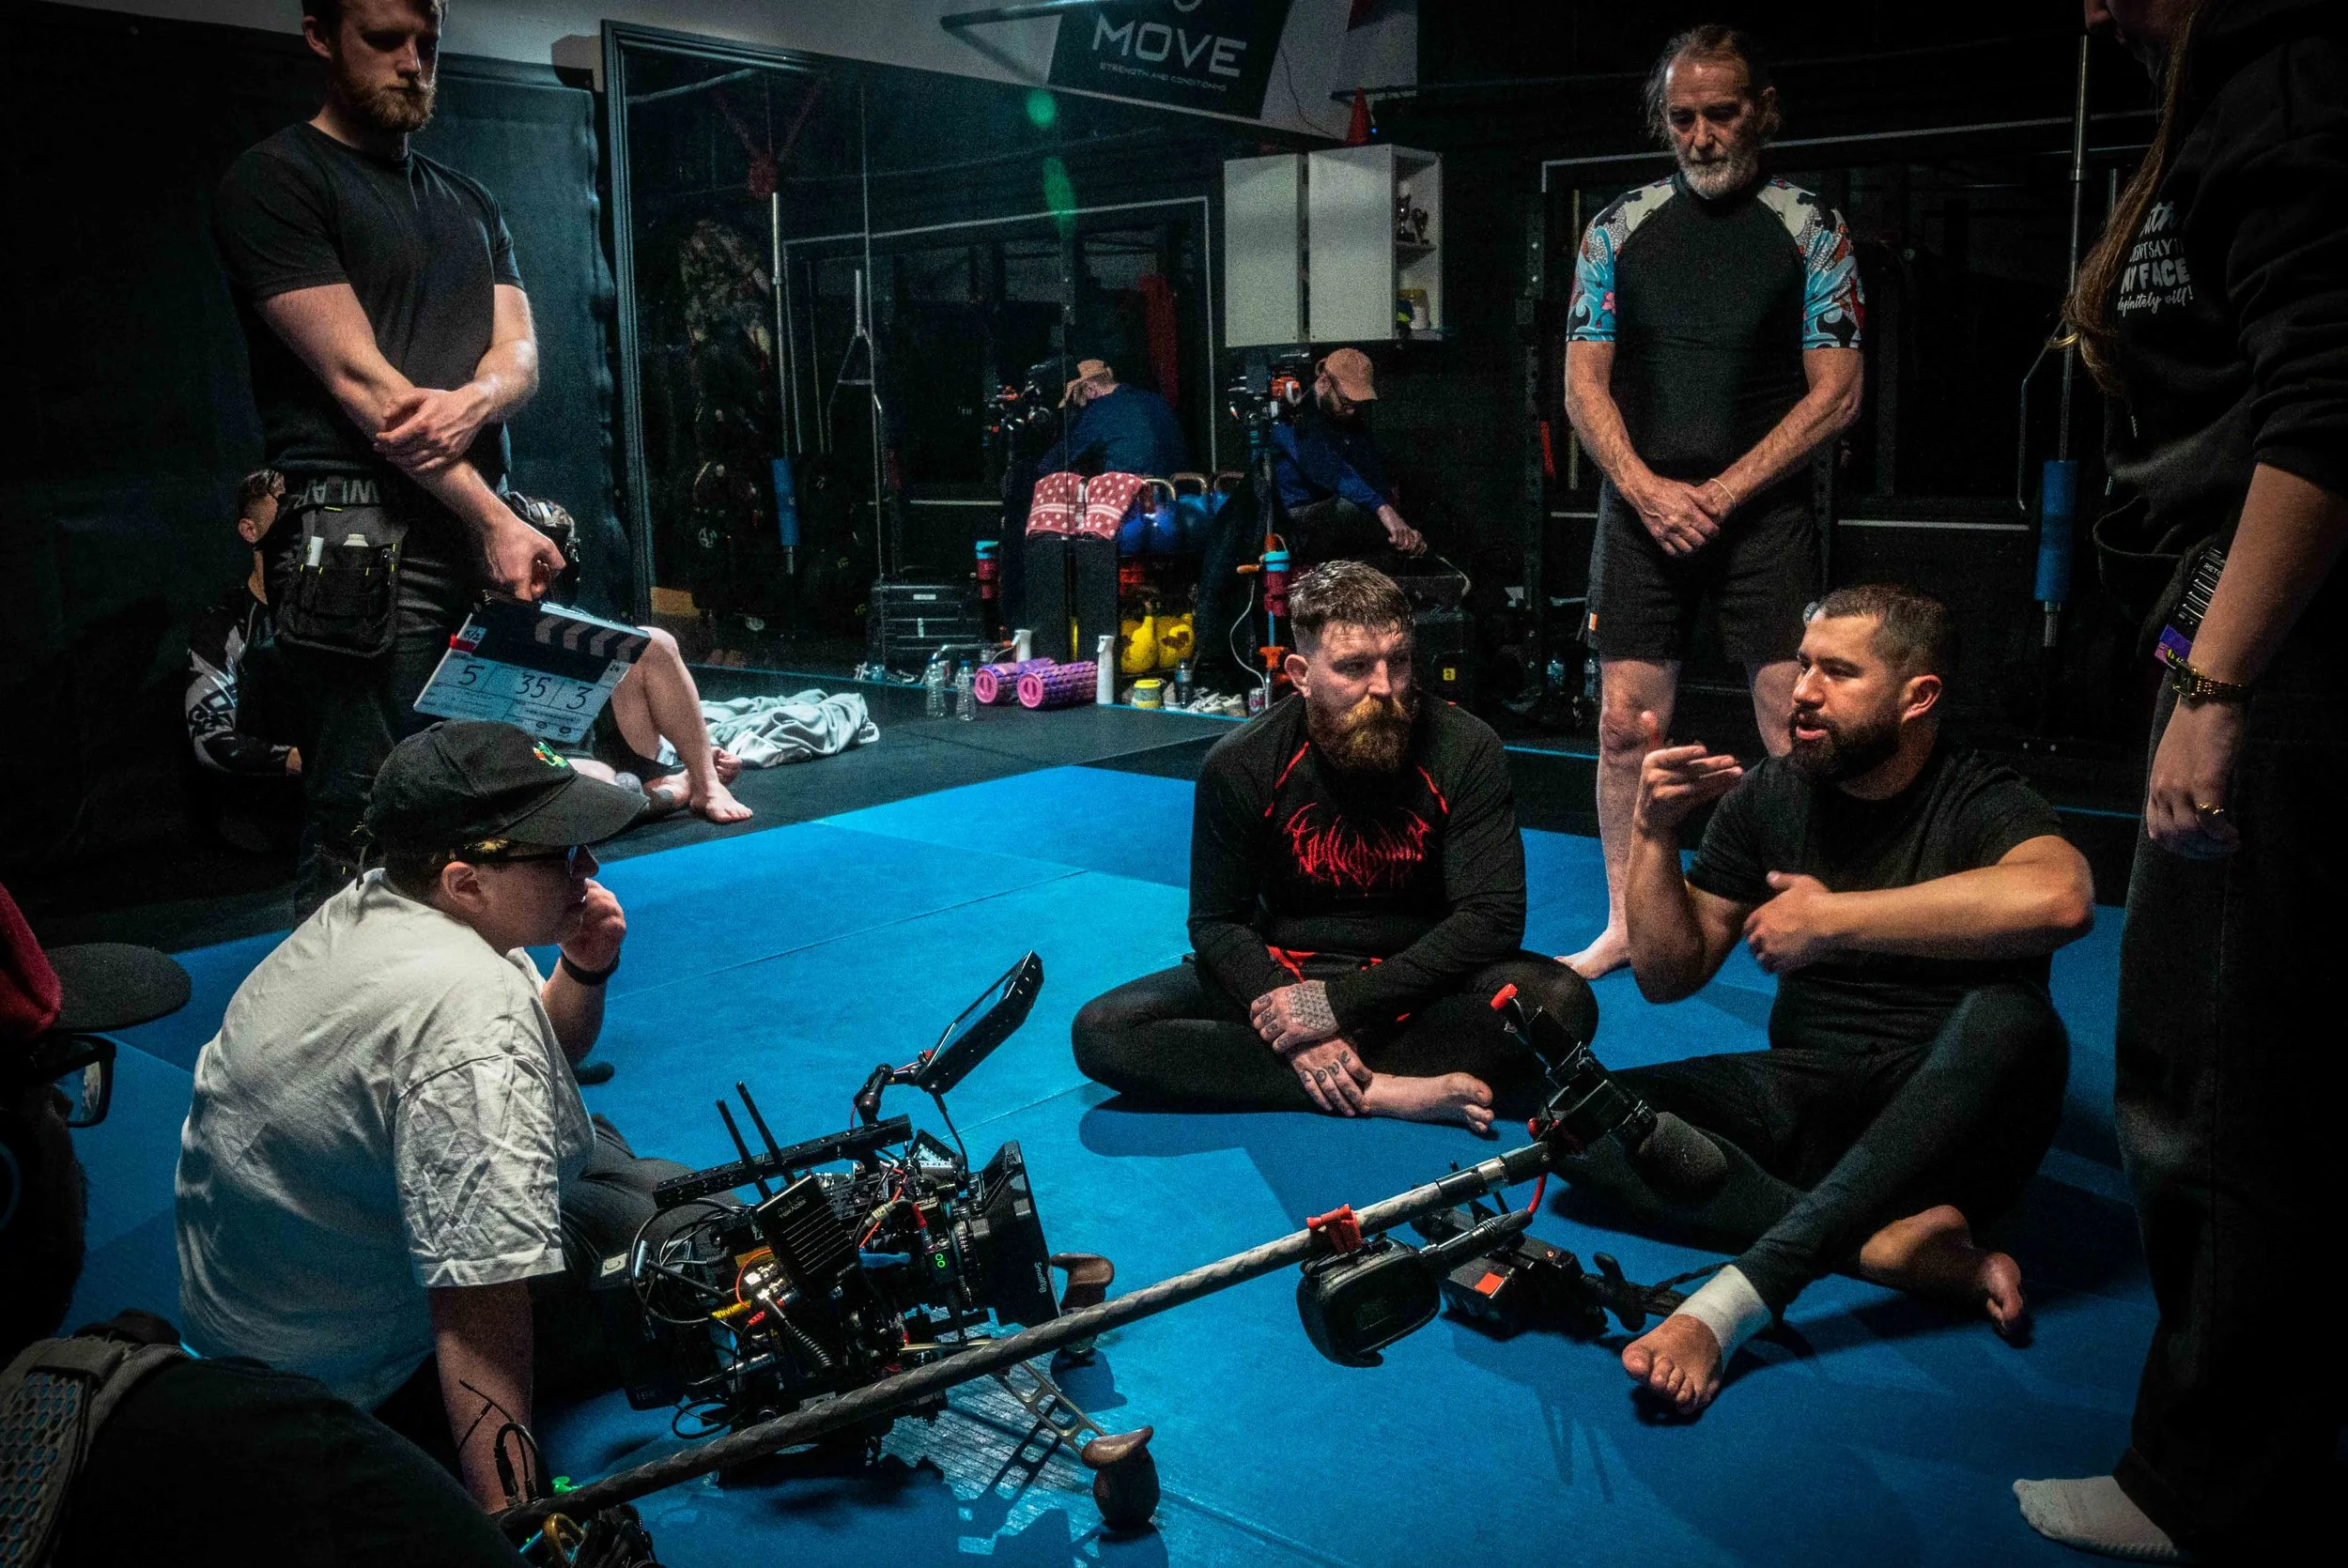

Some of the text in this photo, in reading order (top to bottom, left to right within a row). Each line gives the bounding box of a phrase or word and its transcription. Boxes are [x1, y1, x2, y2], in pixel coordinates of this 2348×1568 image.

[1091, 13, 1247, 77] MOVE
[2139, 257, 2191, 290] FACE
[457, 665, 594, 710] 5 35 3
